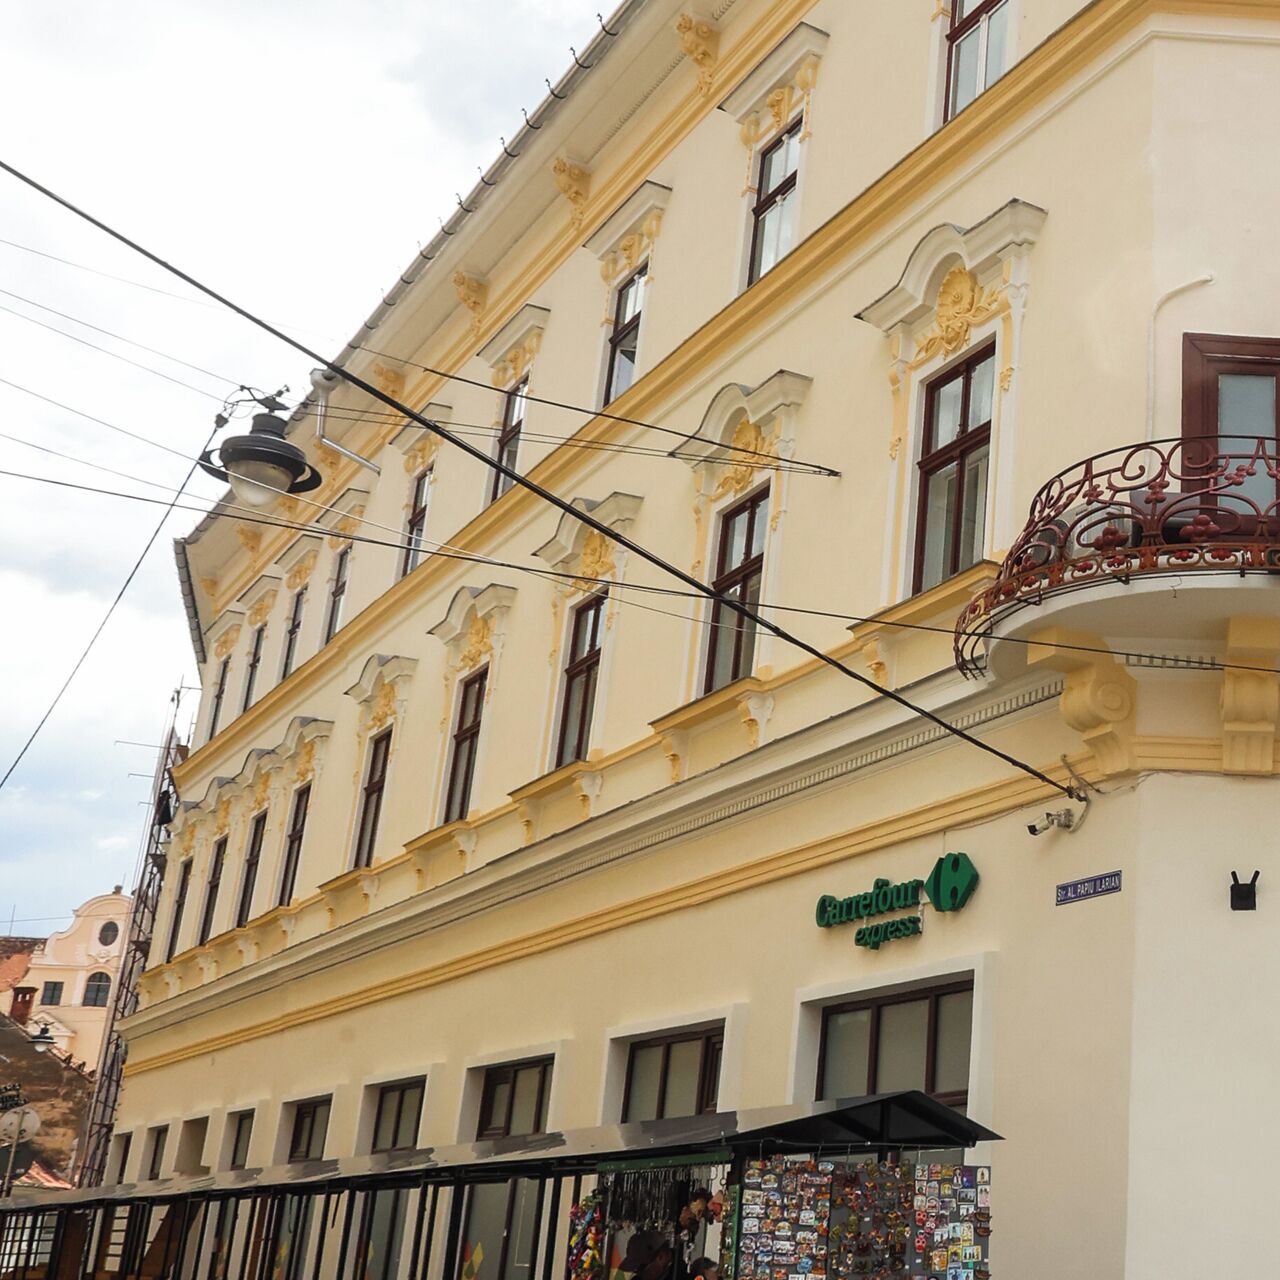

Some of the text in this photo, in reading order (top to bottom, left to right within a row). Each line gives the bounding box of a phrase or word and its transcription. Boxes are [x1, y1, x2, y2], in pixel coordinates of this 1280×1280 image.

[816, 878, 924, 927] Carrefour
[1077, 881, 1095, 896] PAPIU
[1096, 875, 1120, 892] ILARIAN
[854, 916, 922, 950] express
